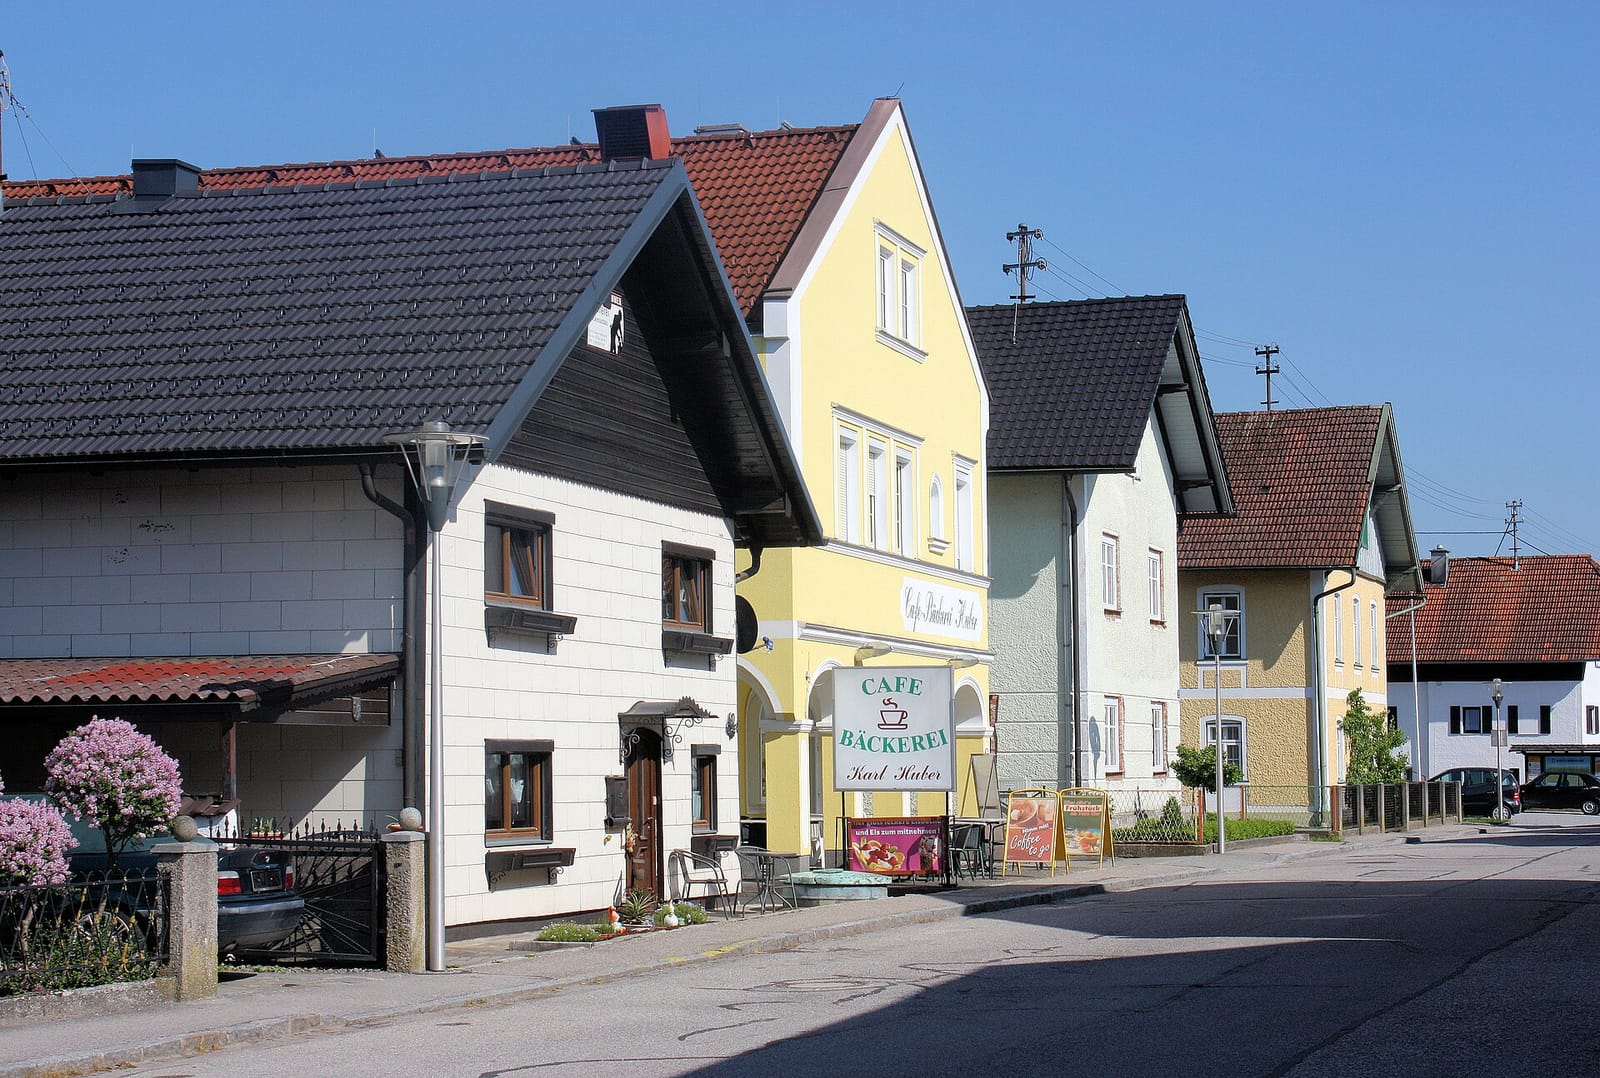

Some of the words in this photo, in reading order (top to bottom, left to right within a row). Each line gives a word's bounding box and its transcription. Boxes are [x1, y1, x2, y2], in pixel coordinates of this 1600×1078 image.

[955, 600, 978, 630] Huber
[861, 676, 923, 696] CAFE
[839, 728, 949, 754] BÄCKEREI
[846, 764, 888, 781] Karl
[894, 764, 941, 781] Huber
[896, 827, 937, 835] mitnehmen
[1010, 833, 1041, 850] Coffee
[1029, 844, 1037, 856] to
[1039, 844, 1050, 858] go
